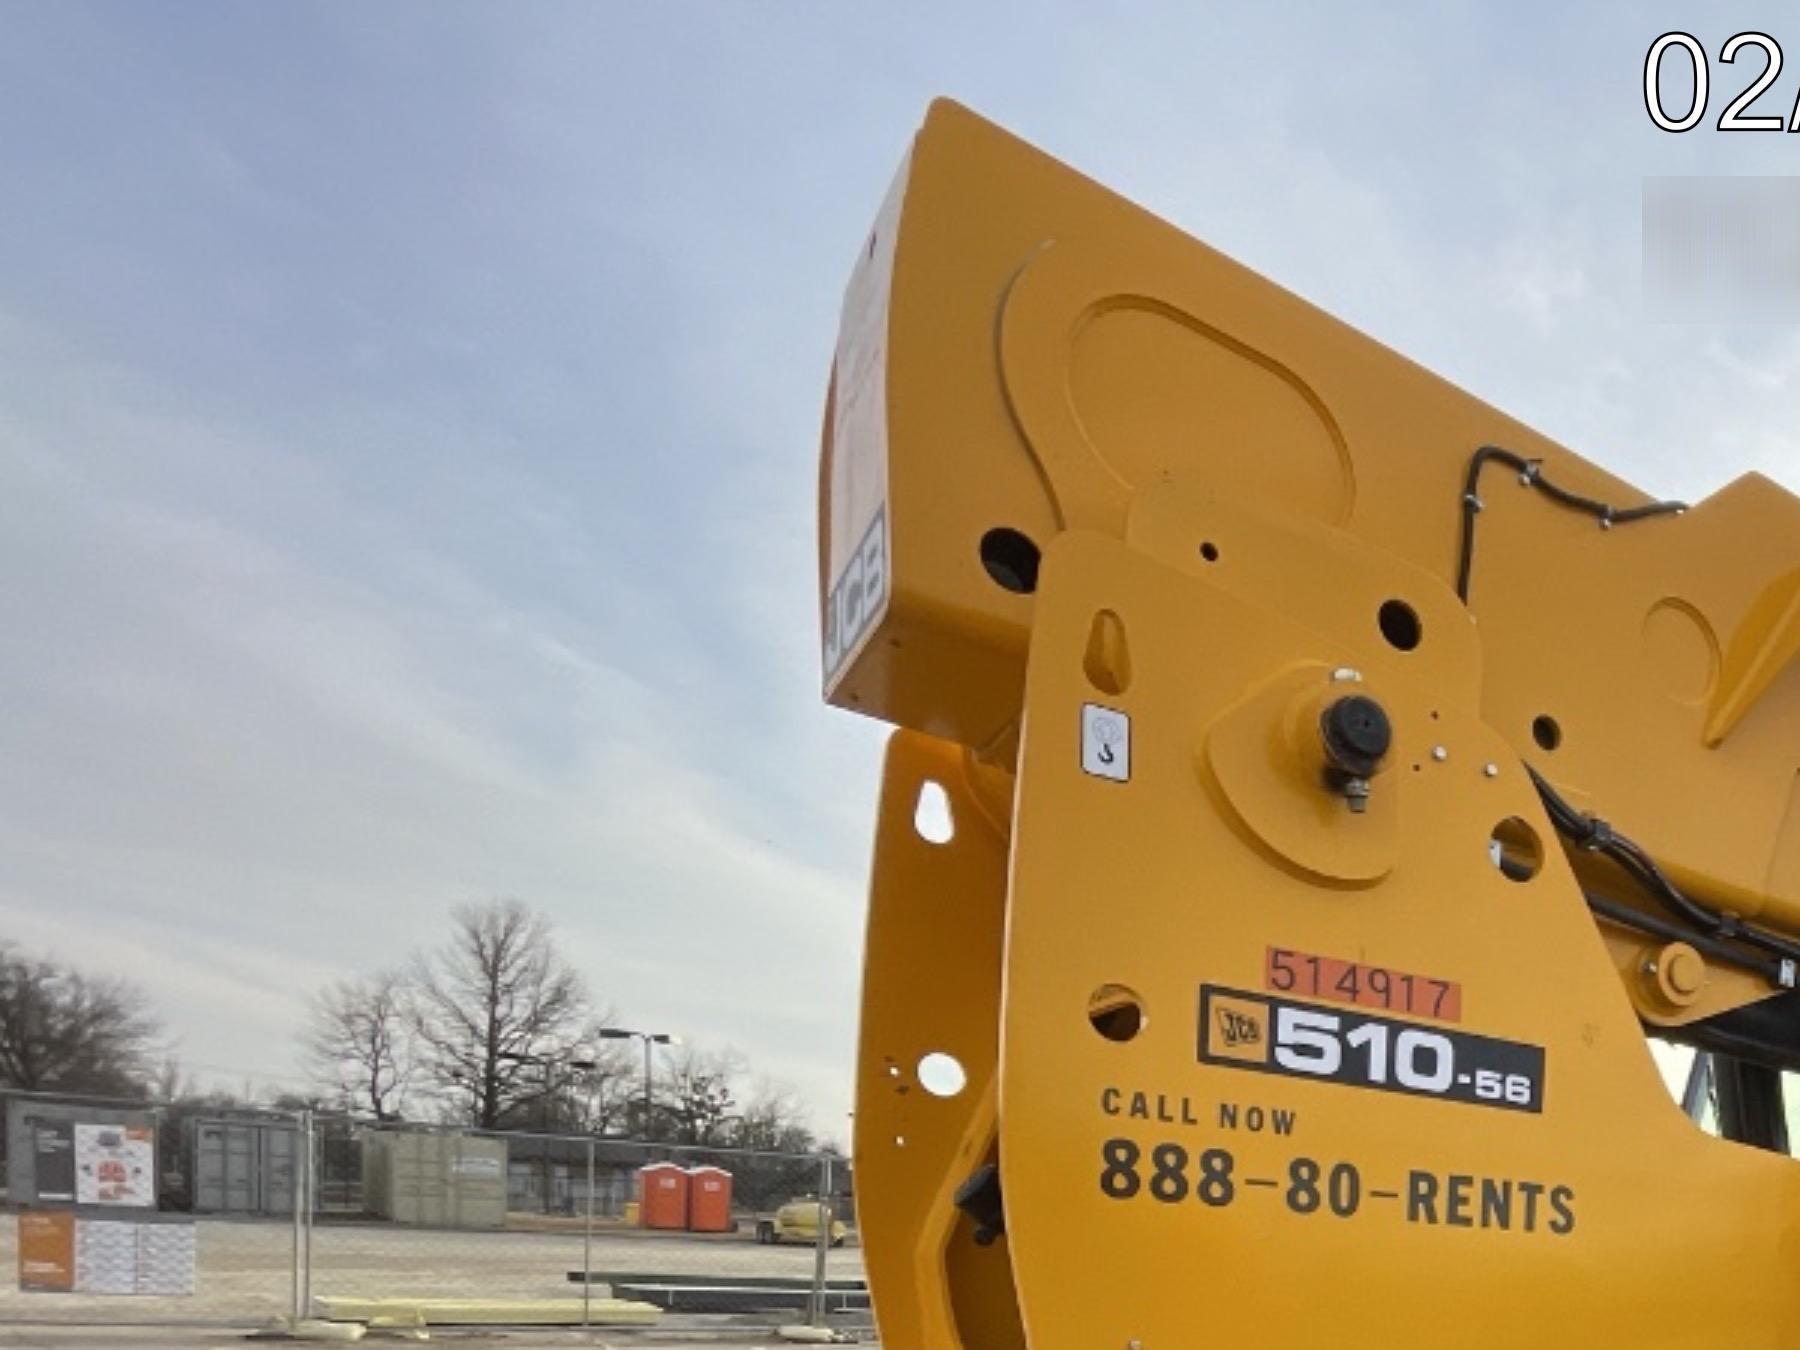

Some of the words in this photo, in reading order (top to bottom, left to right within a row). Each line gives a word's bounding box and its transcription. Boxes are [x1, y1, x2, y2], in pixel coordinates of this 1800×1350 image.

[1271, 950, 1450, 1019] 514917
[1274, 1006, 1532, 1105] 510-56
[1102, 1088, 1198, 1125] CALL
[1219, 1102, 1297, 1137] NOW
[1100, 1138, 1577, 1234] 888-80-RENTS
